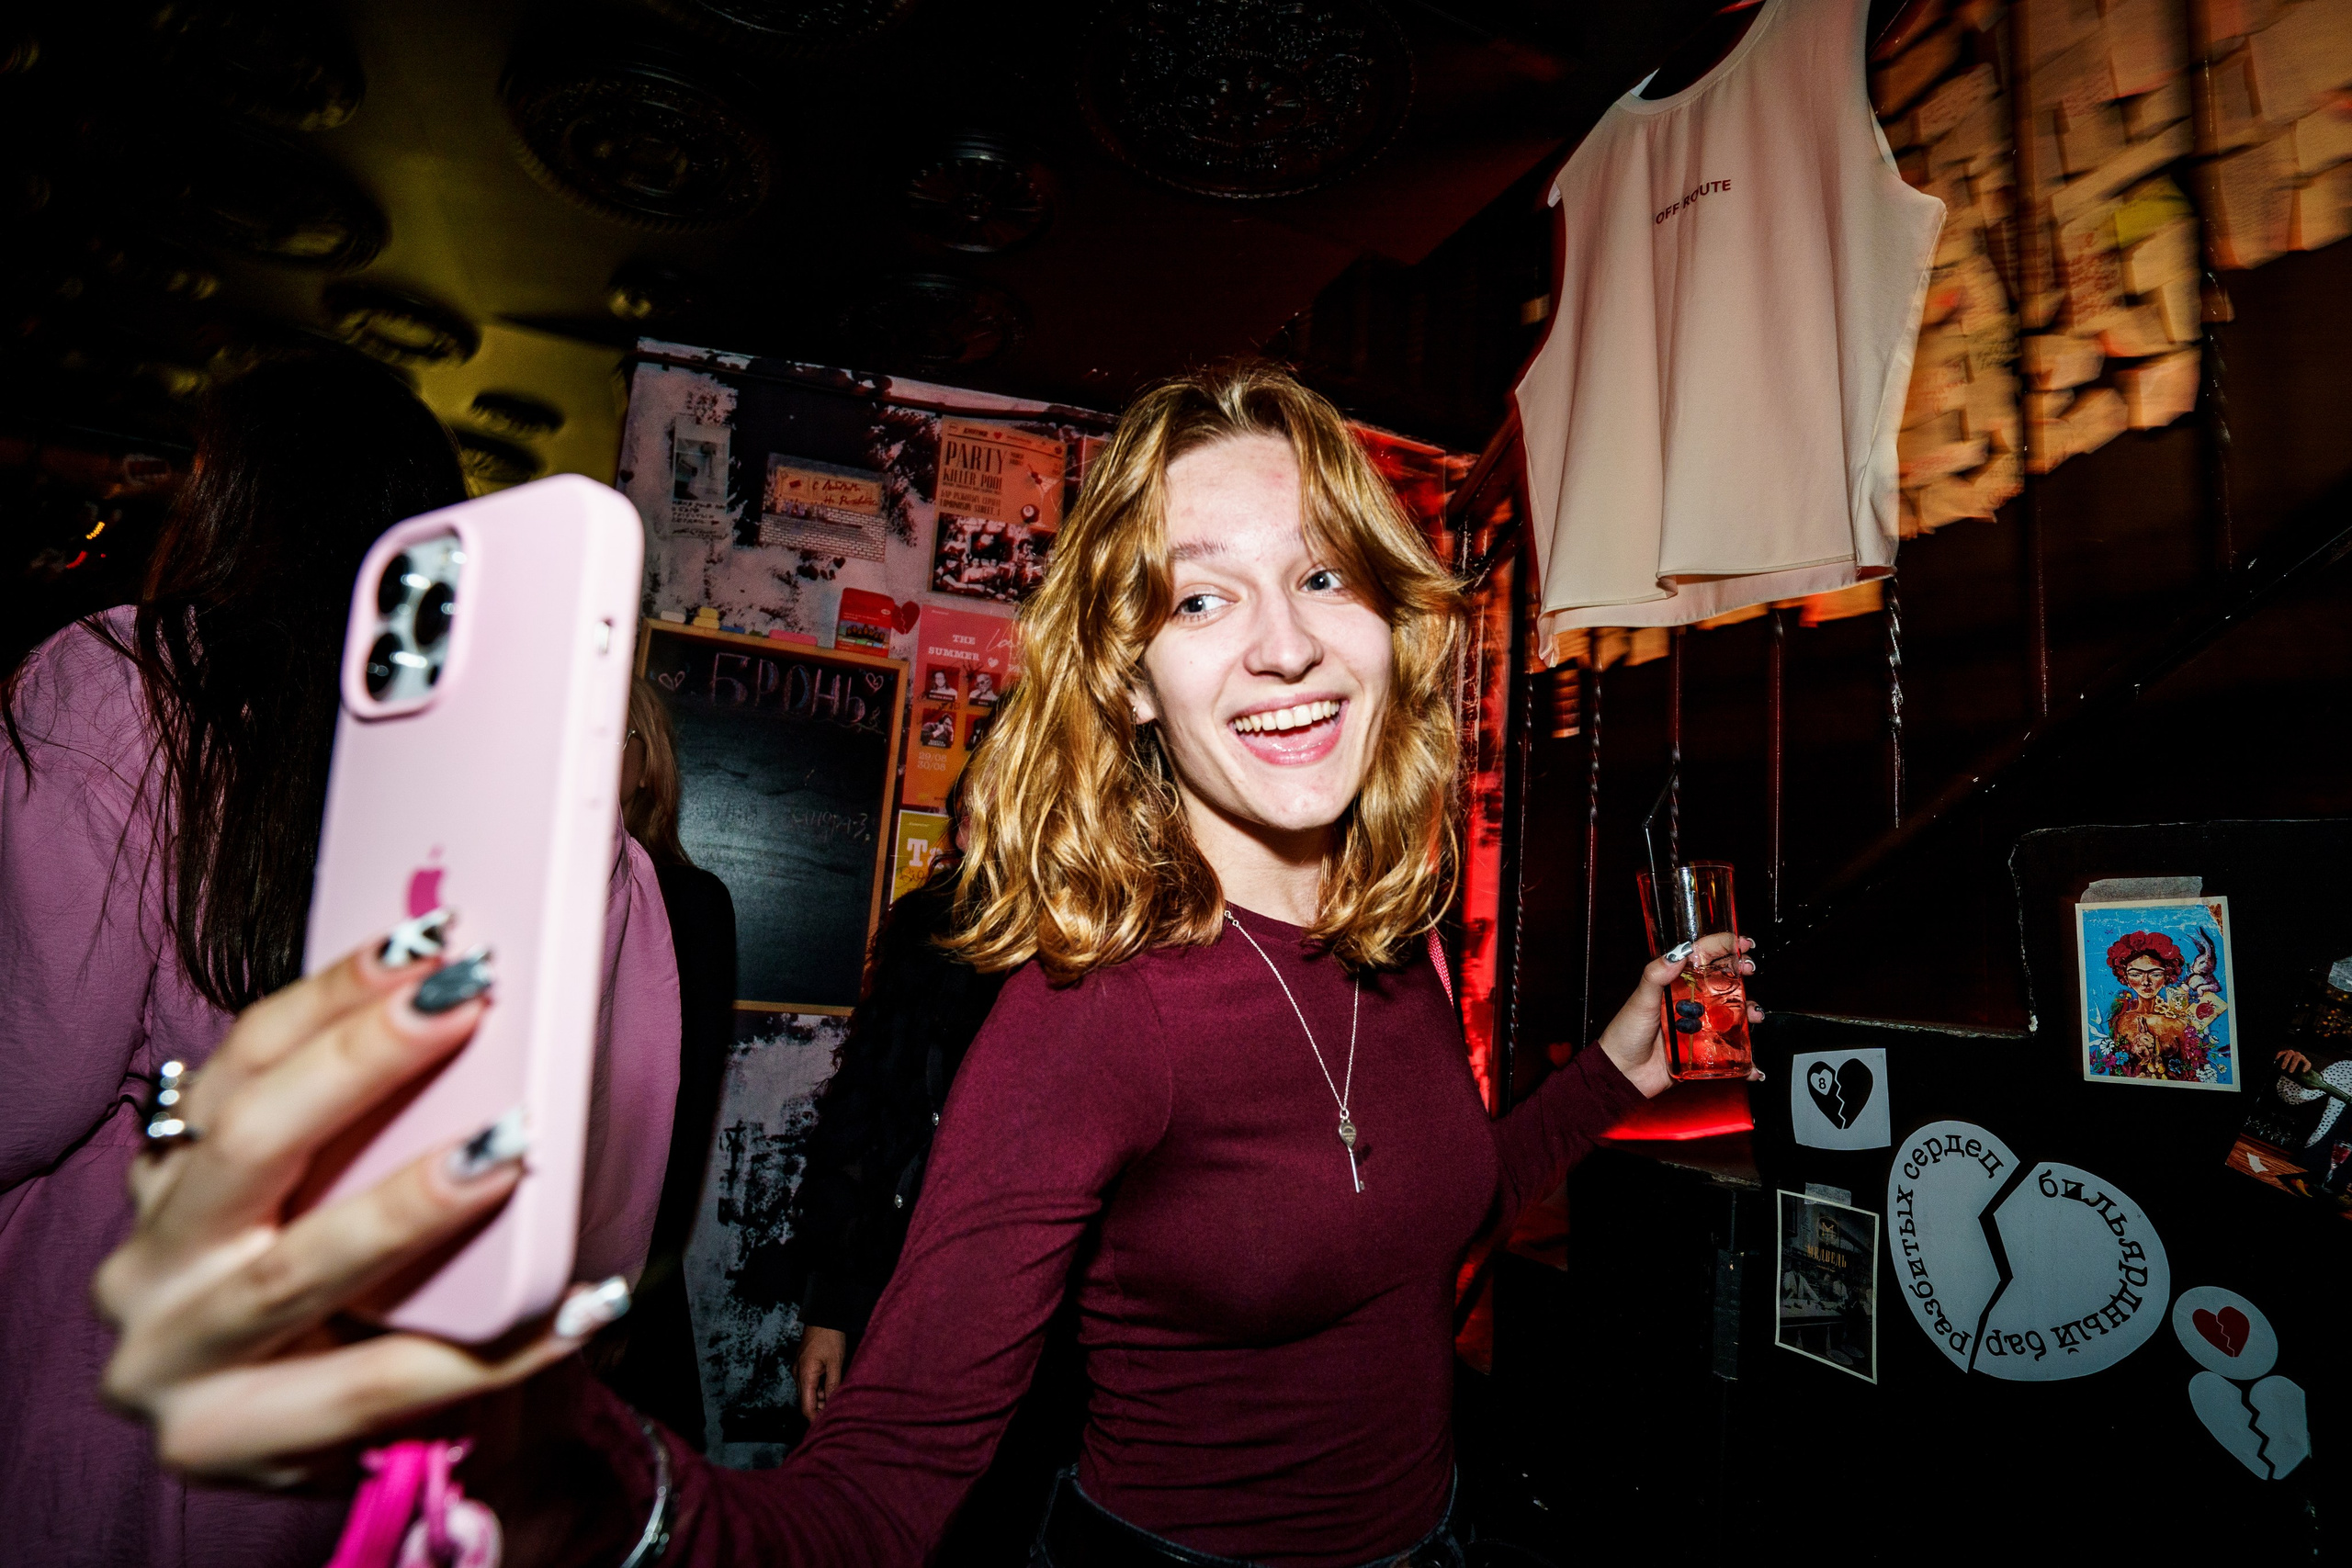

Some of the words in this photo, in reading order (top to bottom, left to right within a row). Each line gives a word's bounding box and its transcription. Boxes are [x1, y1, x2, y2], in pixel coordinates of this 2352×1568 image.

[1656, 202, 1679, 225] OFF
[1683, 179, 1731, 209] ROUTE
[945, 441, 1008, 474] PARTY
[928, 646, 980, 661] SUMMER
[953, 634, 976, 645] THE
[709, 651, 866, 724] БРОНЬ
[1819, 1077, 1826, 1089] 8
[1904, 1134, 2005, 1180] сердец
[1896, 1184, 1973, 1356] разбитых
[2038, 1168, 2149, 1355] бильярдный
[1985, 1329, 2047, 1362] бар
